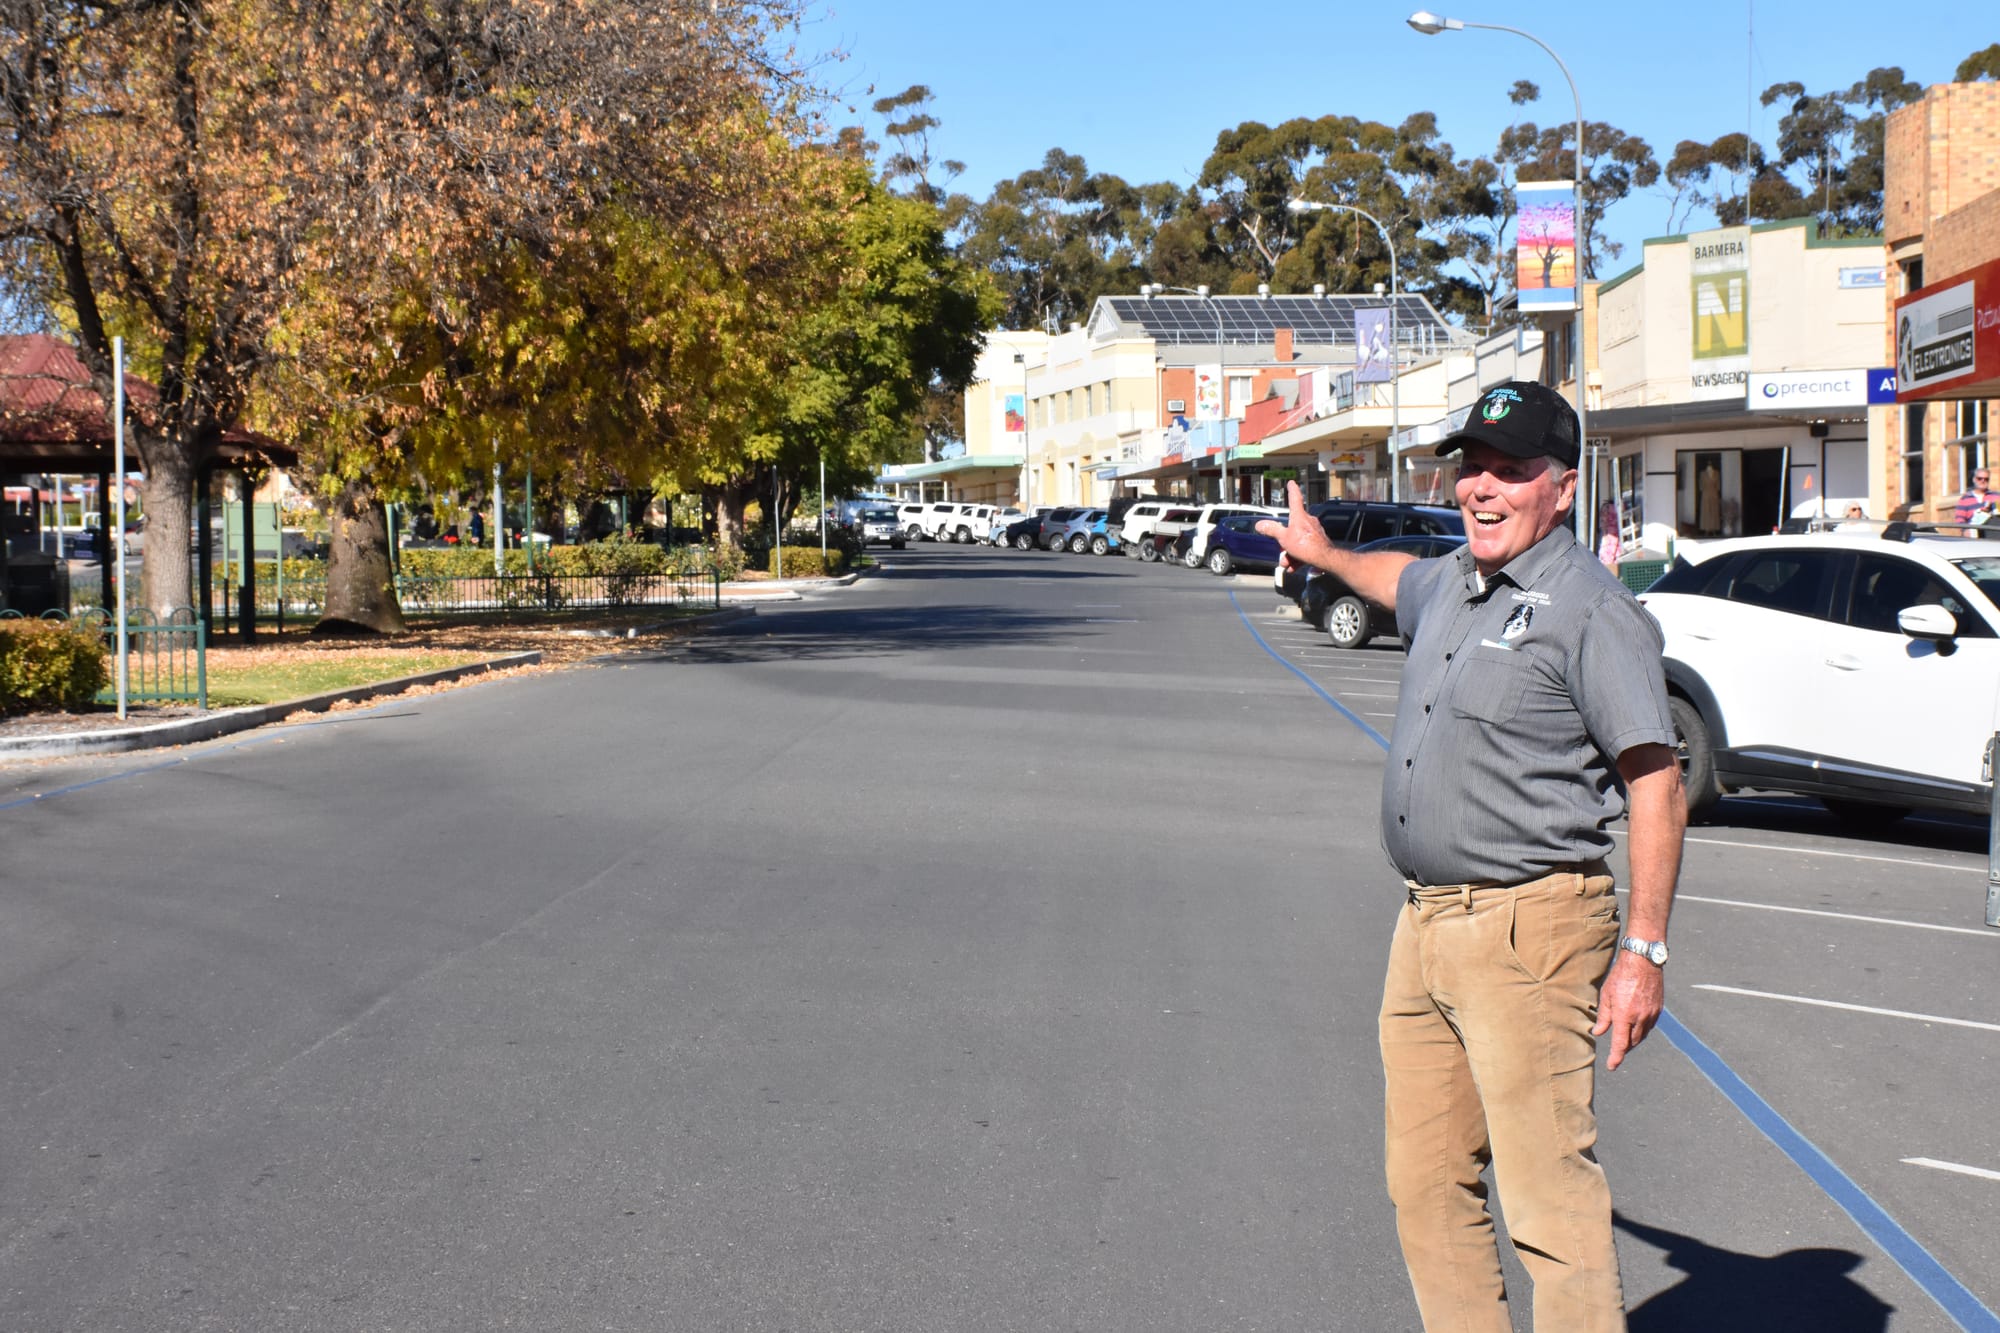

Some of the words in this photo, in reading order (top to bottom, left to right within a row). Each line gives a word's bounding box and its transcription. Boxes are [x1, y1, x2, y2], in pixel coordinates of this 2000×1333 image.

[1695, 241, 1744, 260] BARMERA
[1914, 336, 1972, 374] ELECTRONICS
[1692, 370, 1750, 388] NEWSAGENC
[1781, 378, 1852, 397] precinct
[1879, 377, 1897, 391] AT
